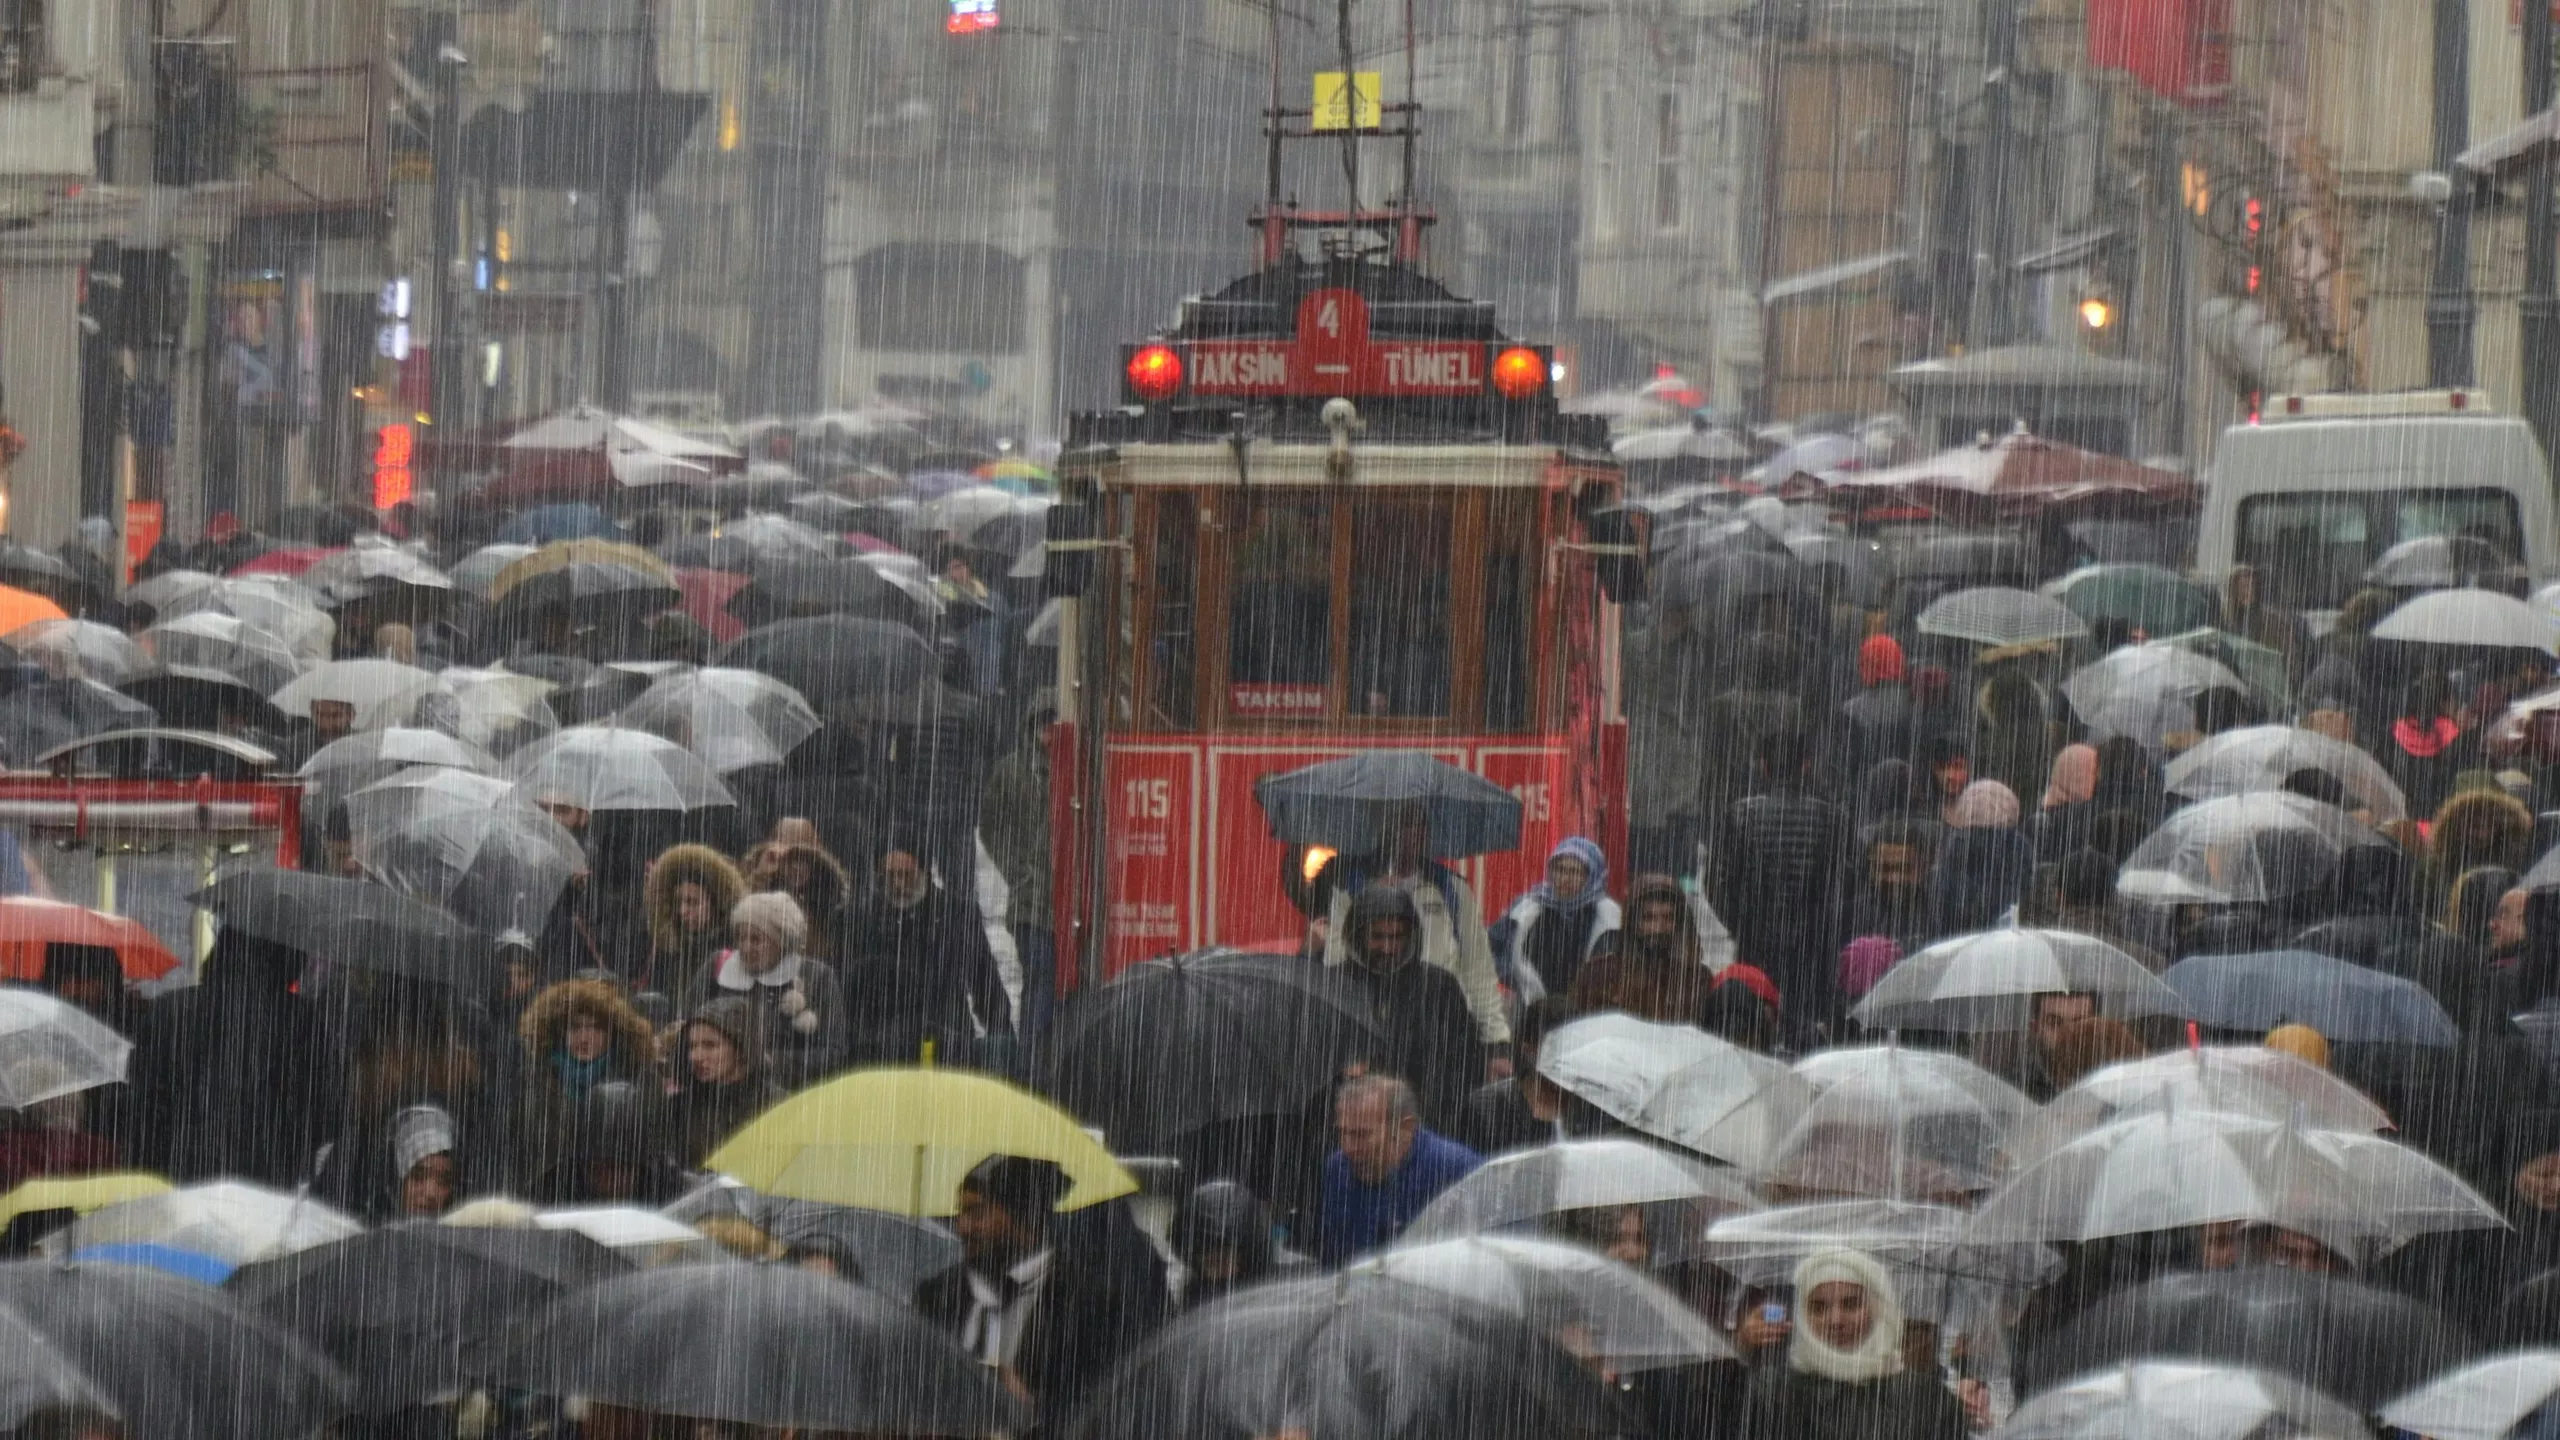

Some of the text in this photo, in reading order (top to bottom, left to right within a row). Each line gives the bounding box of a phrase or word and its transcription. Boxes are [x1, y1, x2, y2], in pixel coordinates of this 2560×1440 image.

[1318, 299, 1341, 338] 4
[1383, 346, 1480, 387] TÜNEL
[1126, 779, 1170, 819] 115
